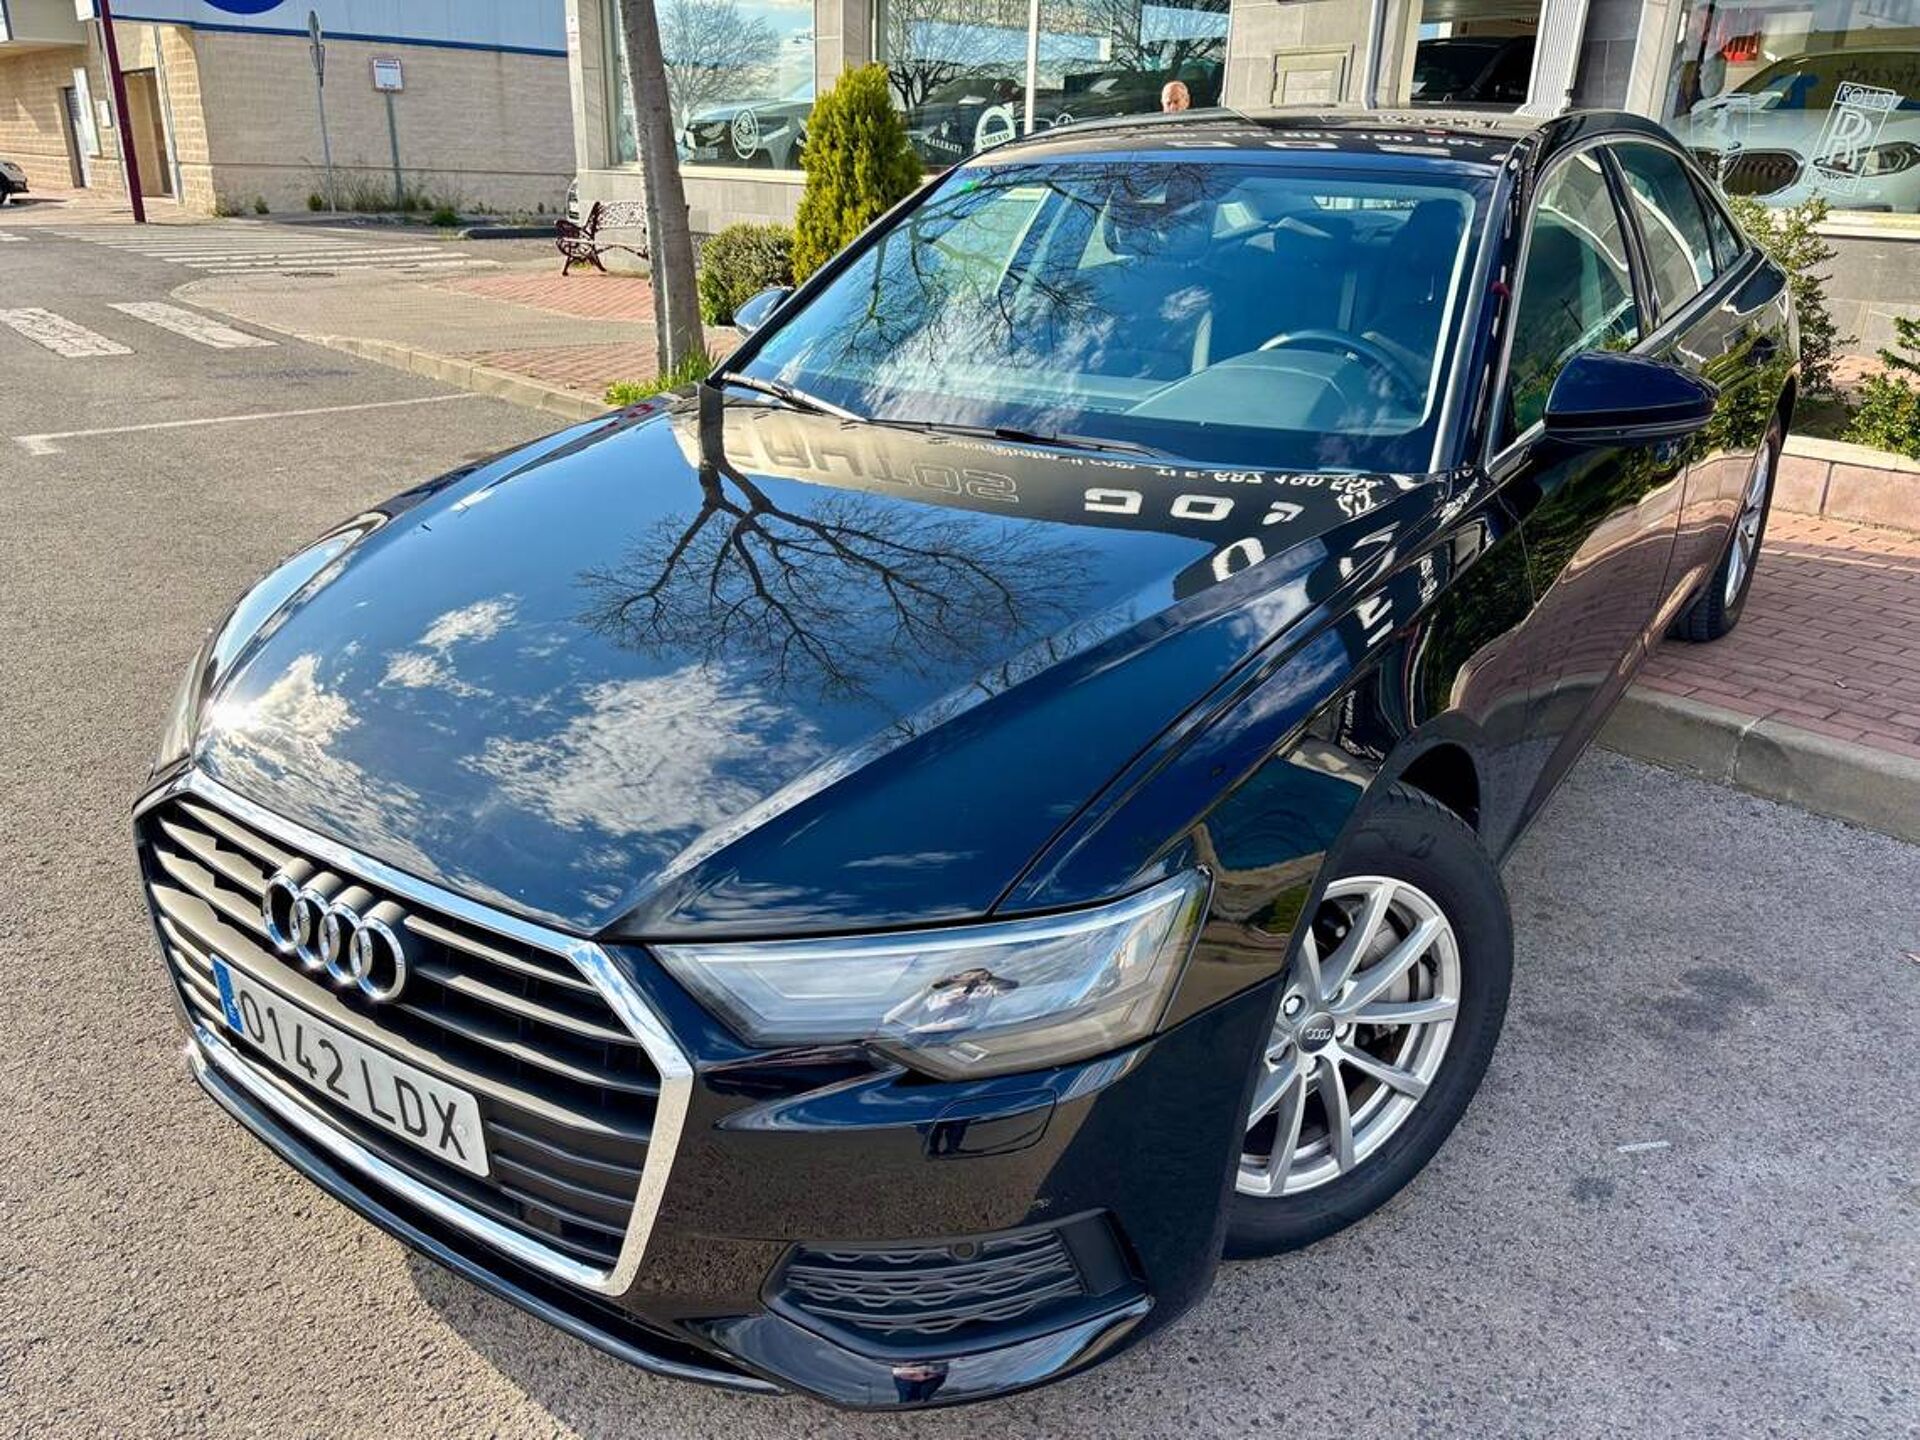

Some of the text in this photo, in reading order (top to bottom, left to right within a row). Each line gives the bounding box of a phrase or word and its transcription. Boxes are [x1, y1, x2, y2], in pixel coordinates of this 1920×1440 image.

[981, 132, 1010, 146] VOLVO
[239, 989, 466, 1161] 0142 LDX
